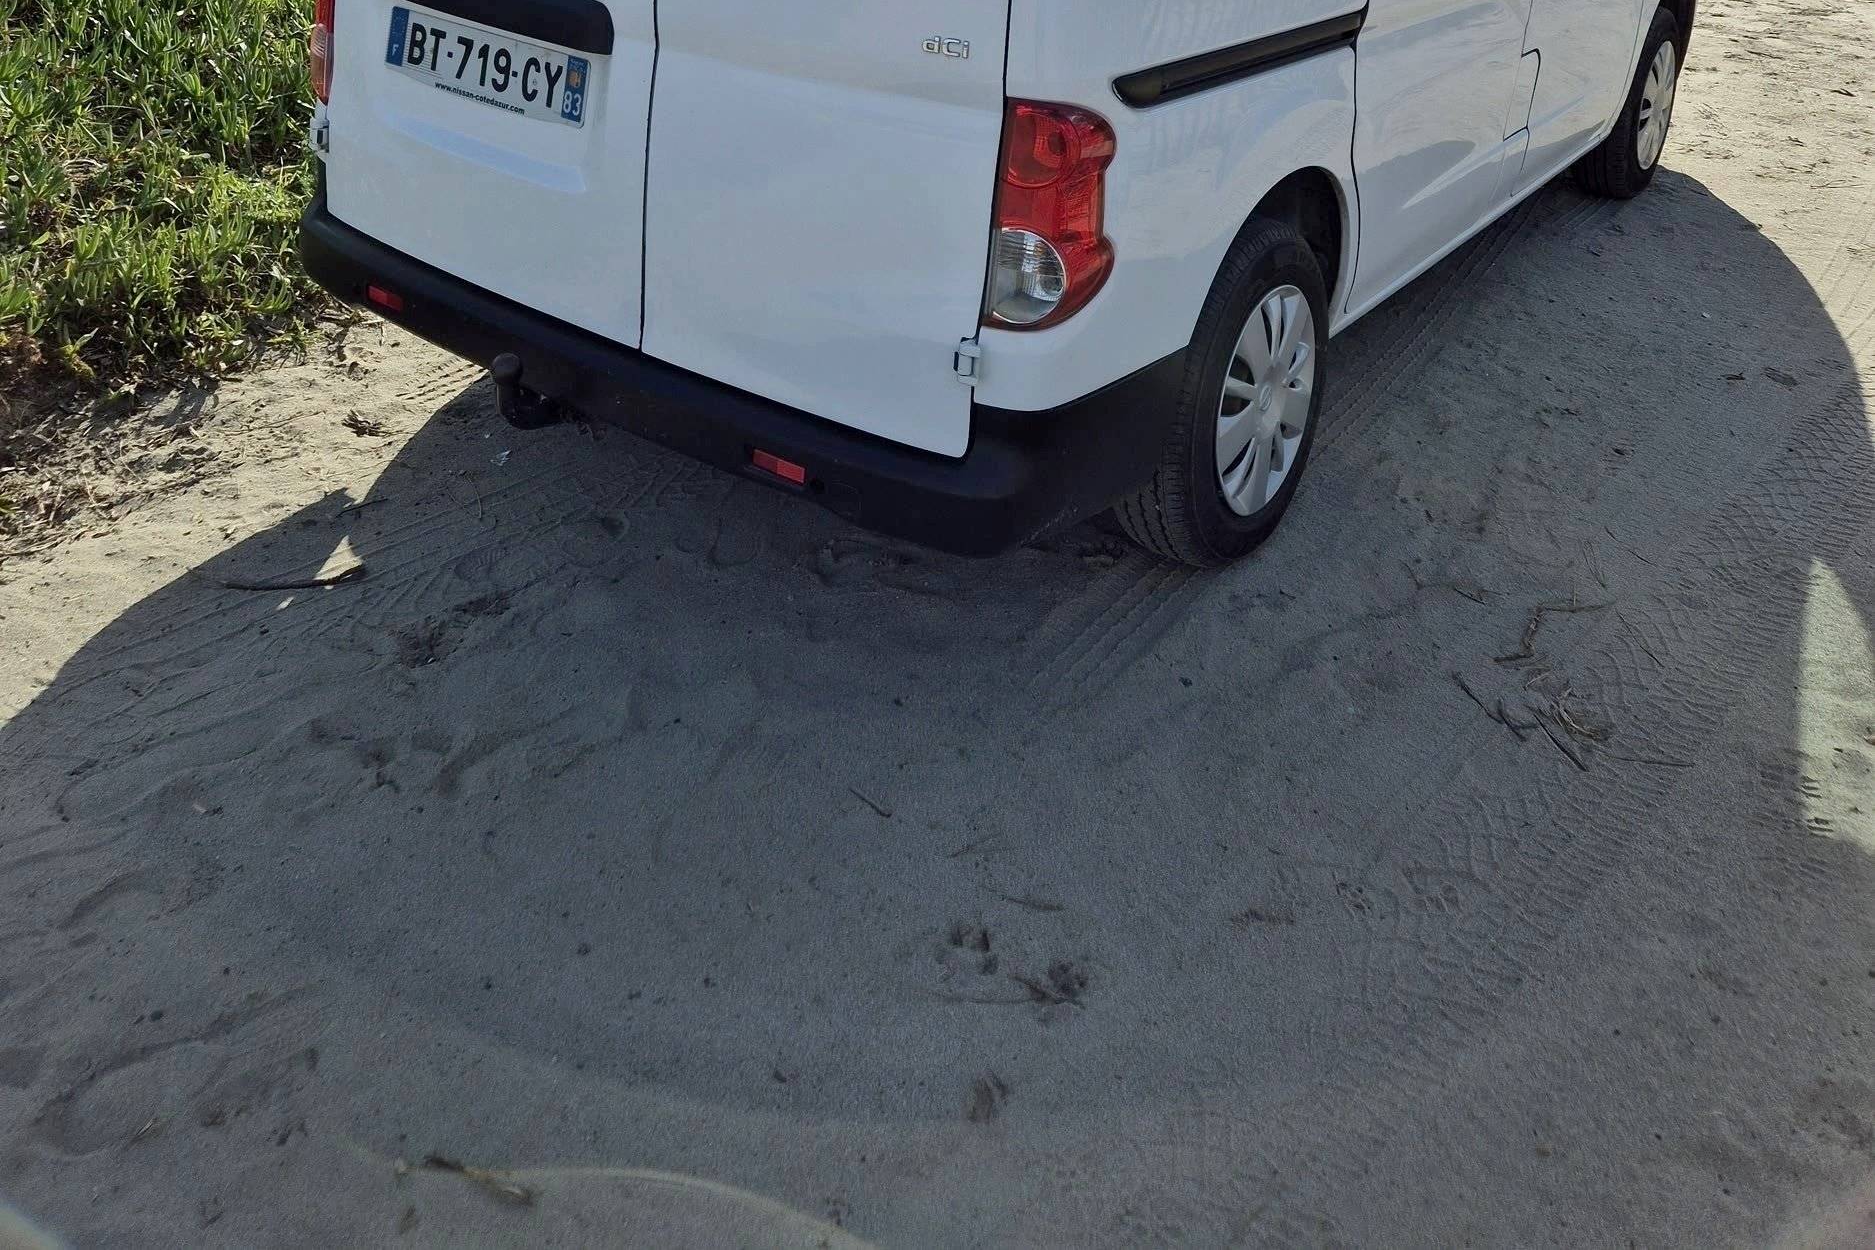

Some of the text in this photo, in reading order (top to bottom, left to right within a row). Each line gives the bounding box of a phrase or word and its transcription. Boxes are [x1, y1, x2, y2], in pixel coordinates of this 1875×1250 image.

[922, 36, 970, 59] dCi
[407, 22, 563, 108] BT-719-CY
[434, 81, 525, 116] www.nissan-cotedazur.com
[563, 90, 582, 116] 83
